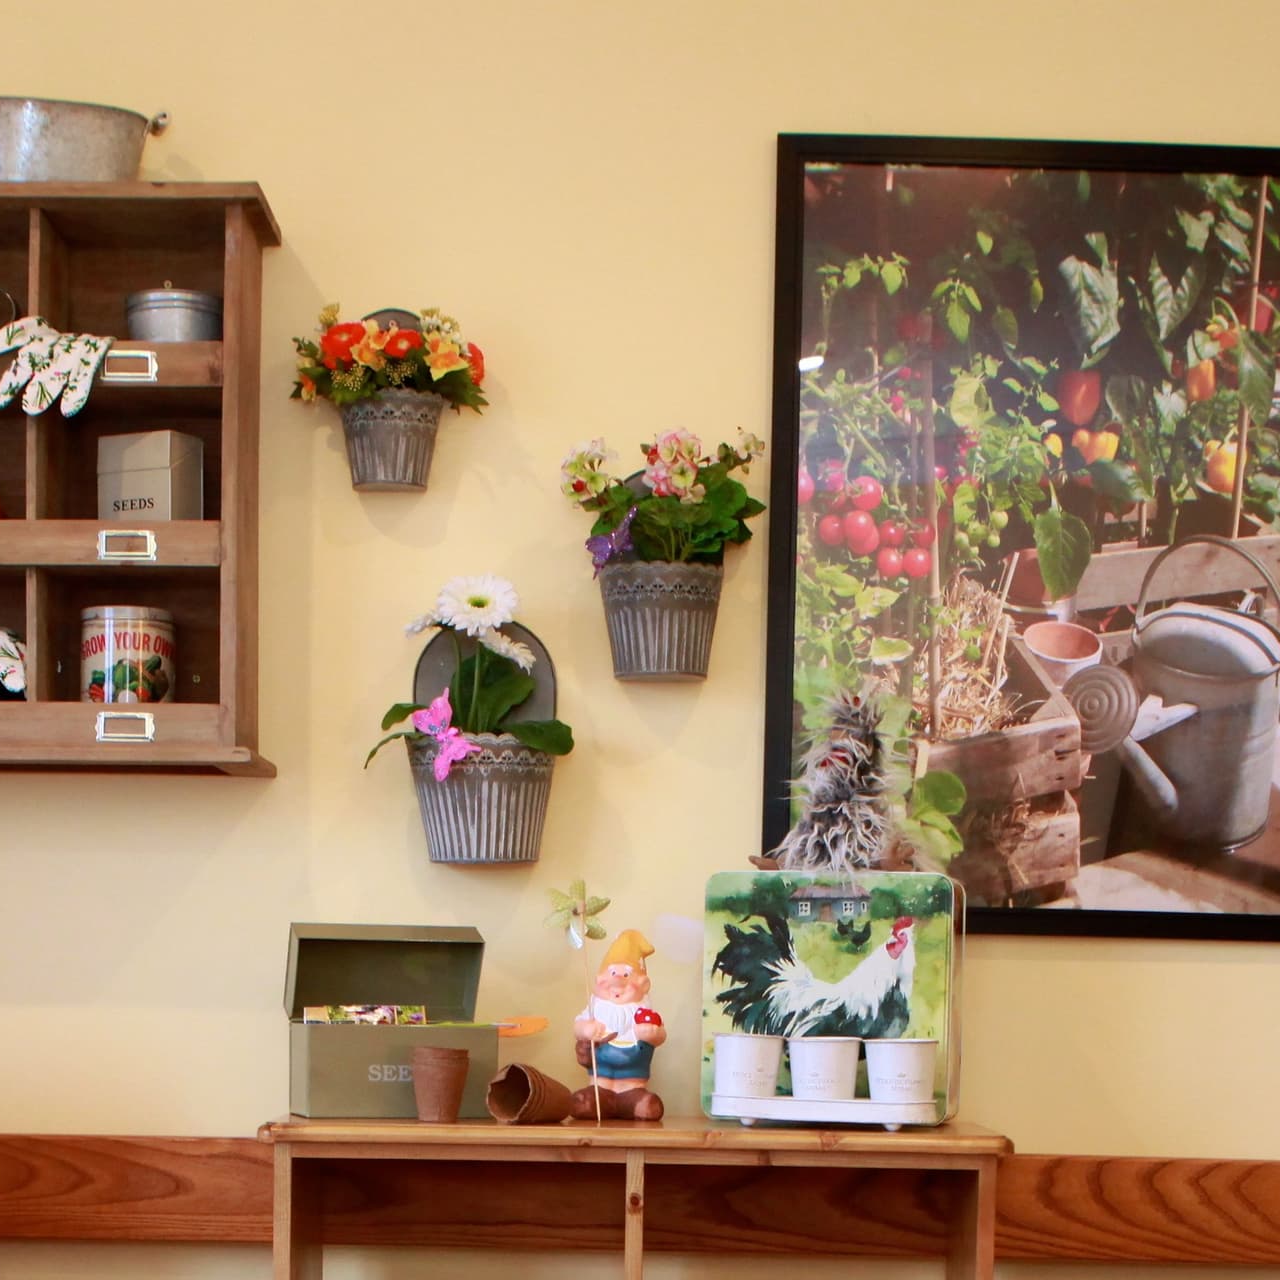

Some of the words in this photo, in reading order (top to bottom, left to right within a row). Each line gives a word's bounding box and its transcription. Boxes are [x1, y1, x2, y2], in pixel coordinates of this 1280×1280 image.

[113, 497, 154, 513] SEEDS
[113, 631, 151, 652] YOUR
[368, 1064, 412, 1082] SEE
